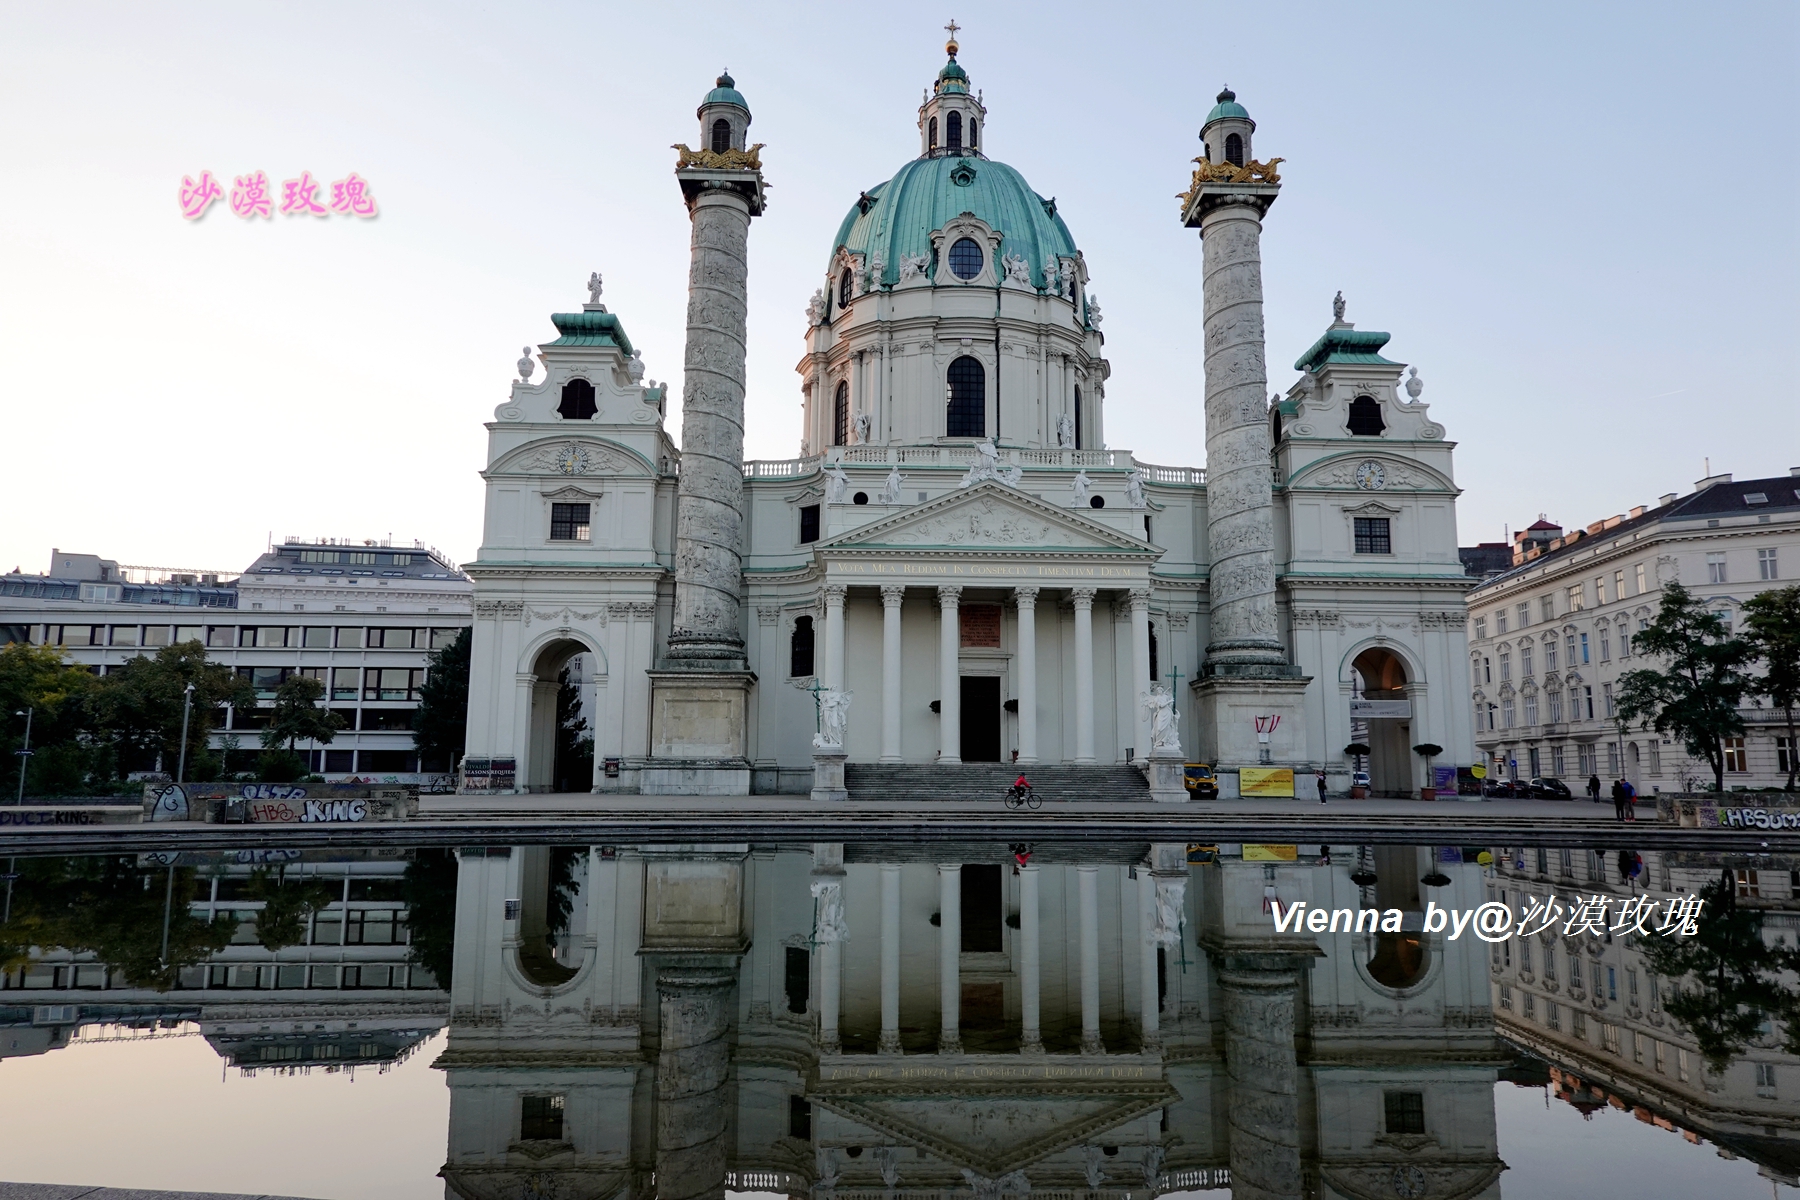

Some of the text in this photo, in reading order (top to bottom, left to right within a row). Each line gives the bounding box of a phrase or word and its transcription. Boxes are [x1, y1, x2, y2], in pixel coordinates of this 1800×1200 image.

[837, 562, 865, 573] VOTA
[872, 563, 896, 573] MEA
[903, 563, 947, 574] REDDAM
[954, 564, 964, 574] IN
[970, 564, 1029, 575] CONSPECTV
[1036, 565, 1094, 576] TIMENTIVM
[1101, 566, 1131, 576] DEVM
